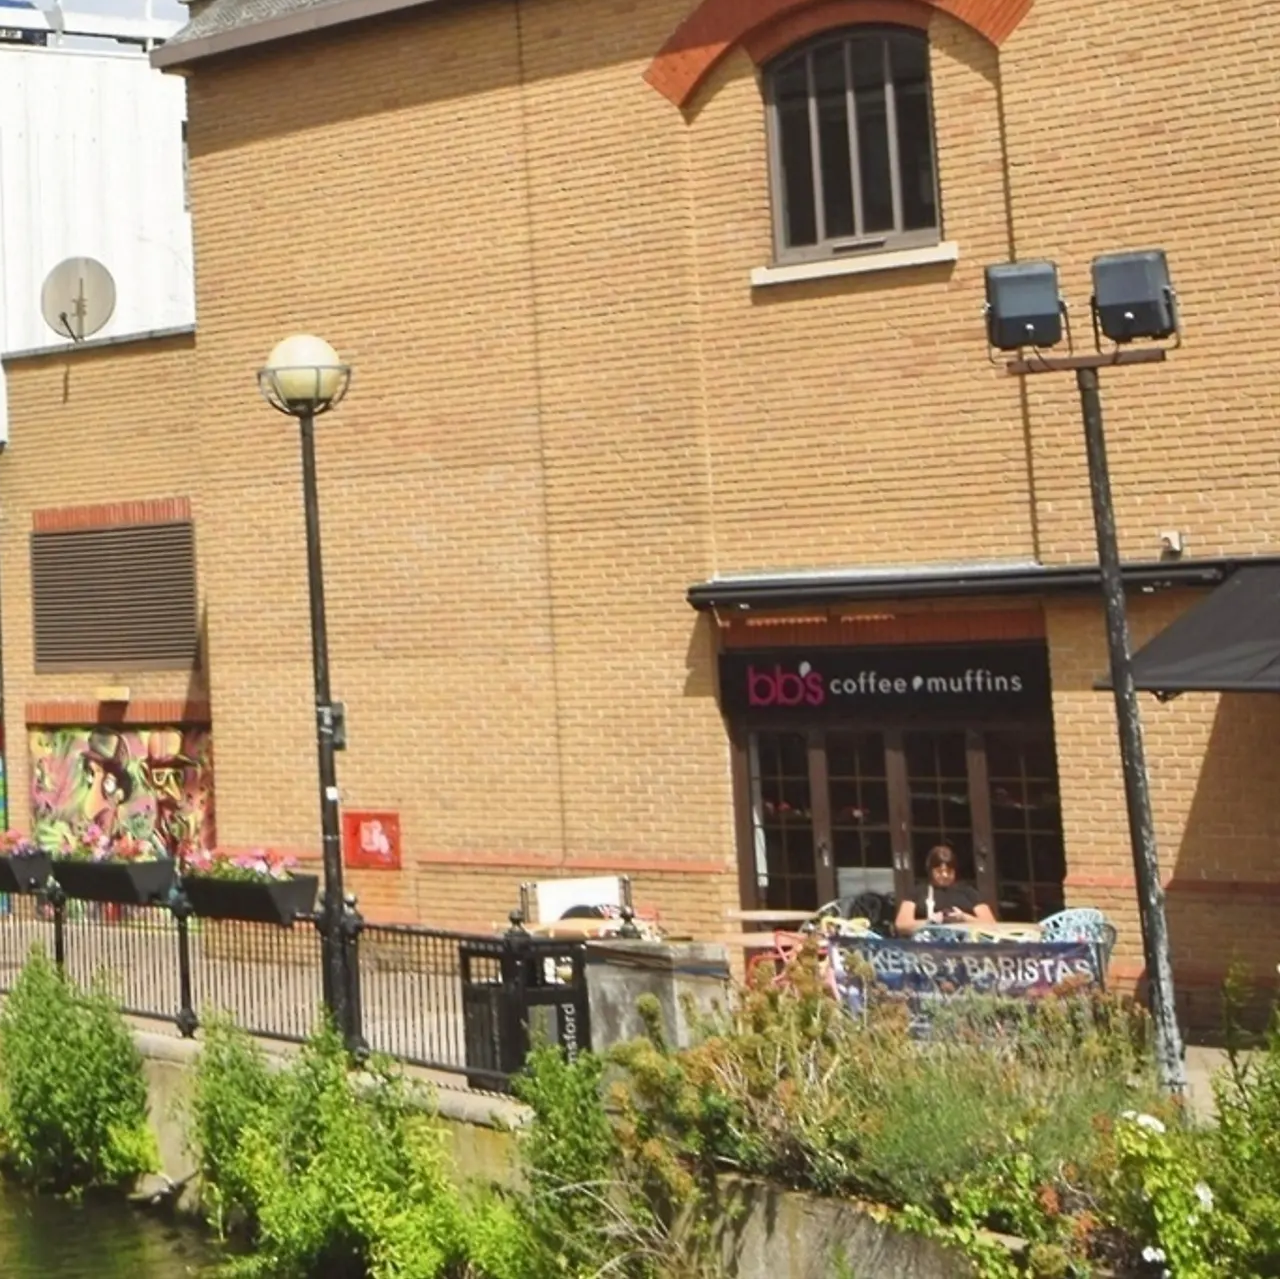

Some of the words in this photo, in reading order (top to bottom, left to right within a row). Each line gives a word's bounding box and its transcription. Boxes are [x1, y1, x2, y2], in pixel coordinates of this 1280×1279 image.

[747, 661, 825, 706] bb's
[829, 671, 907, 695] coffee
[926, 669, 1023, 693] muffins
[961, 955, 1095, 984] BARISTAS
